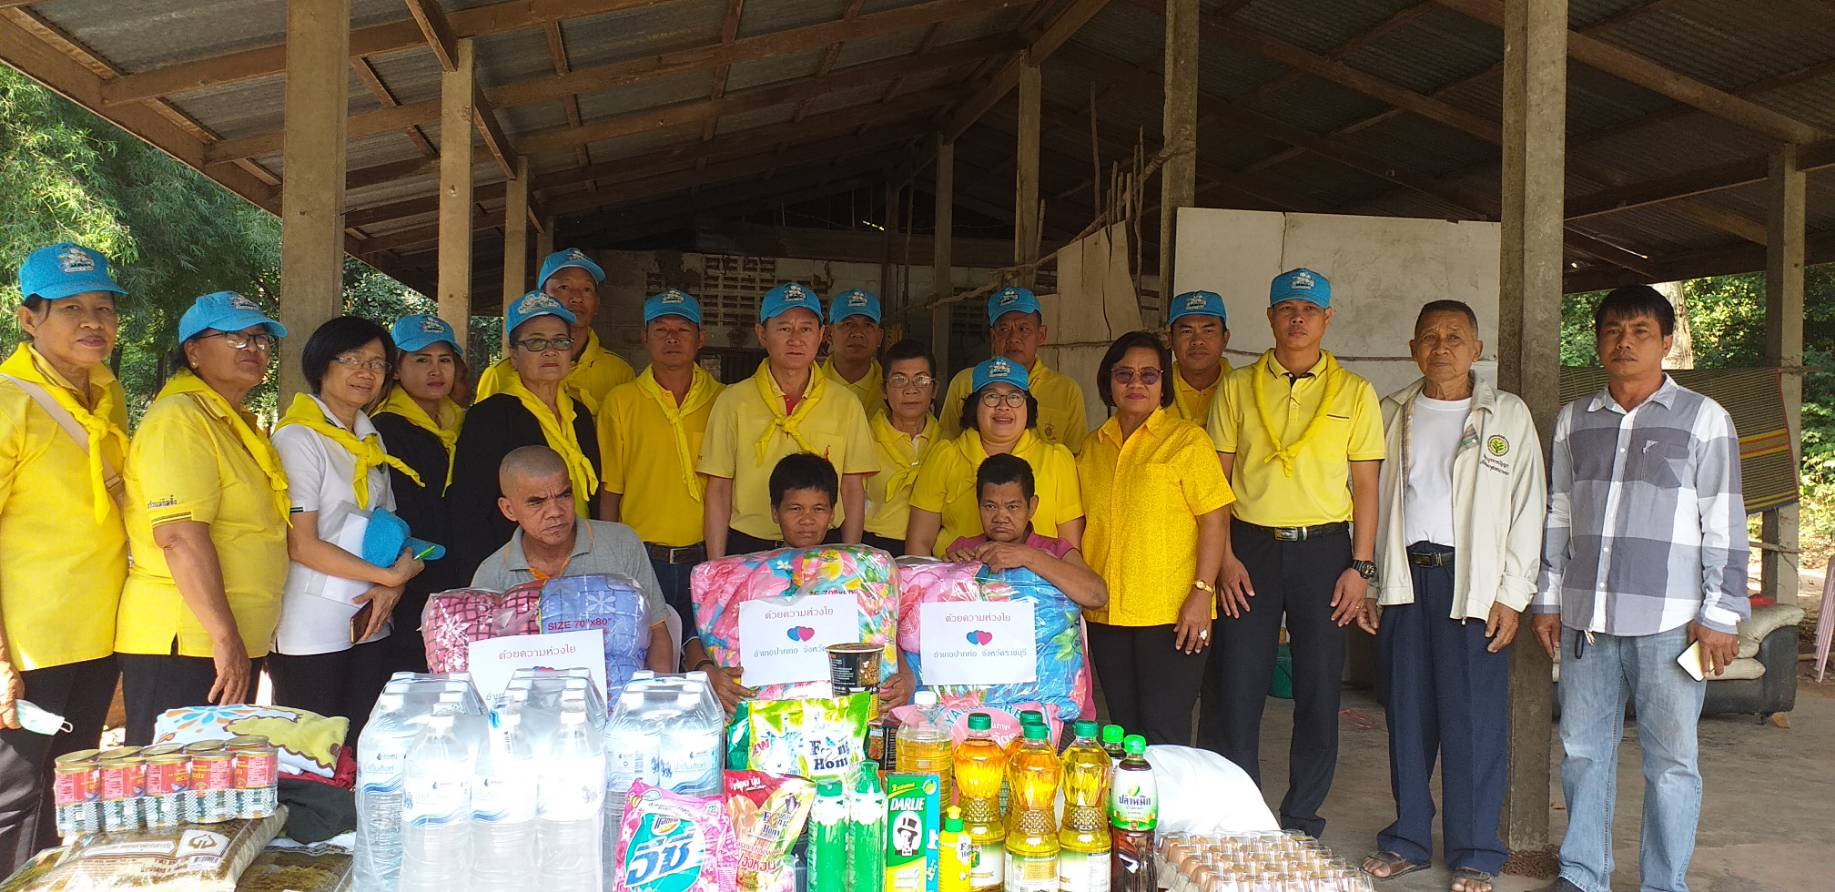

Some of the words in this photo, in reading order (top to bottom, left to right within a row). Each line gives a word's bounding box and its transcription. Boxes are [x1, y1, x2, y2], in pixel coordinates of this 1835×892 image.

[548, 621, 572, 631] SIZE
[498, 643, 576, 660] ด้วยความห่วงใย
[890, 797, 926, 811] DARLIE
[1118, 794, 1151, 806] ปลาหมึก
